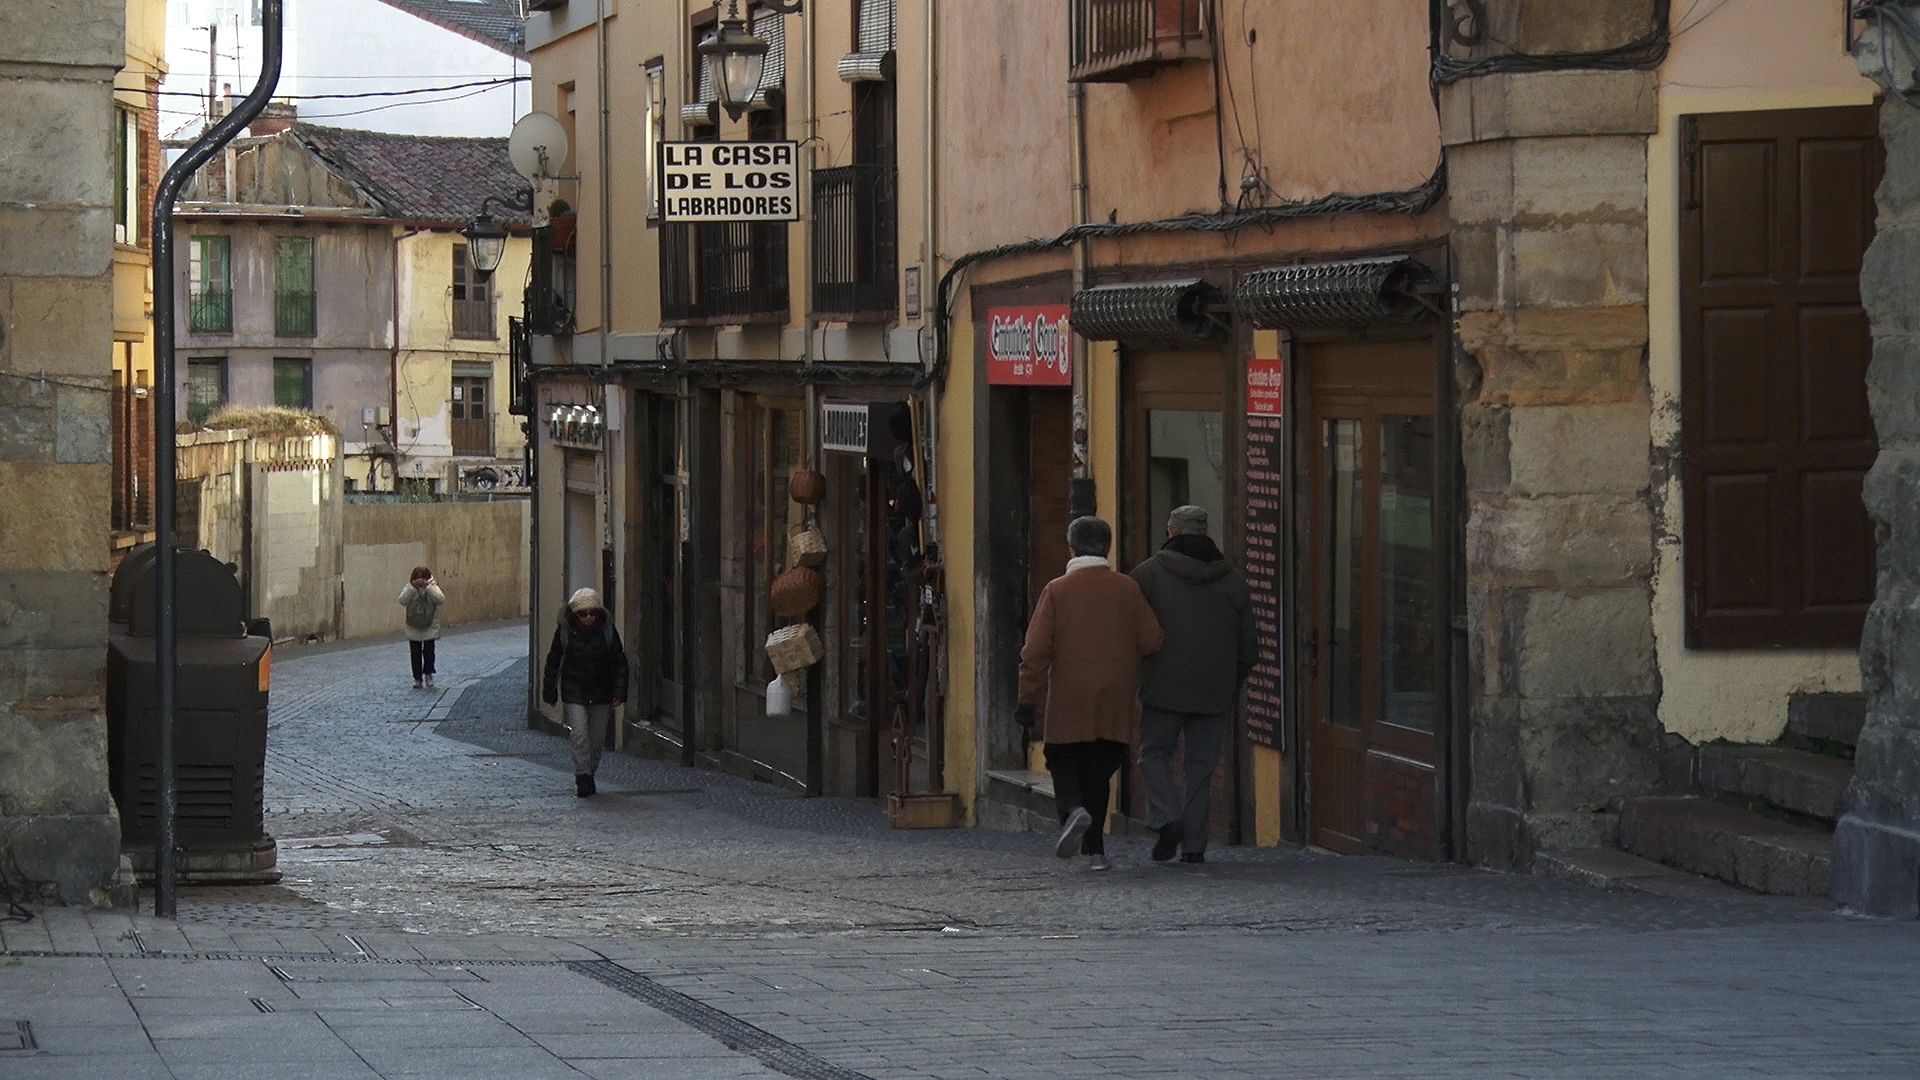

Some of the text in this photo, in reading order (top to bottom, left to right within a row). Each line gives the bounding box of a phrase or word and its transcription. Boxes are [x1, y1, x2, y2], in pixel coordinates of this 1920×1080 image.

[666, 145, 791, 166] LA CASA
[666, 172, 791, 189] DE LOS
[667, 196, 792, 216] LABRADORES
